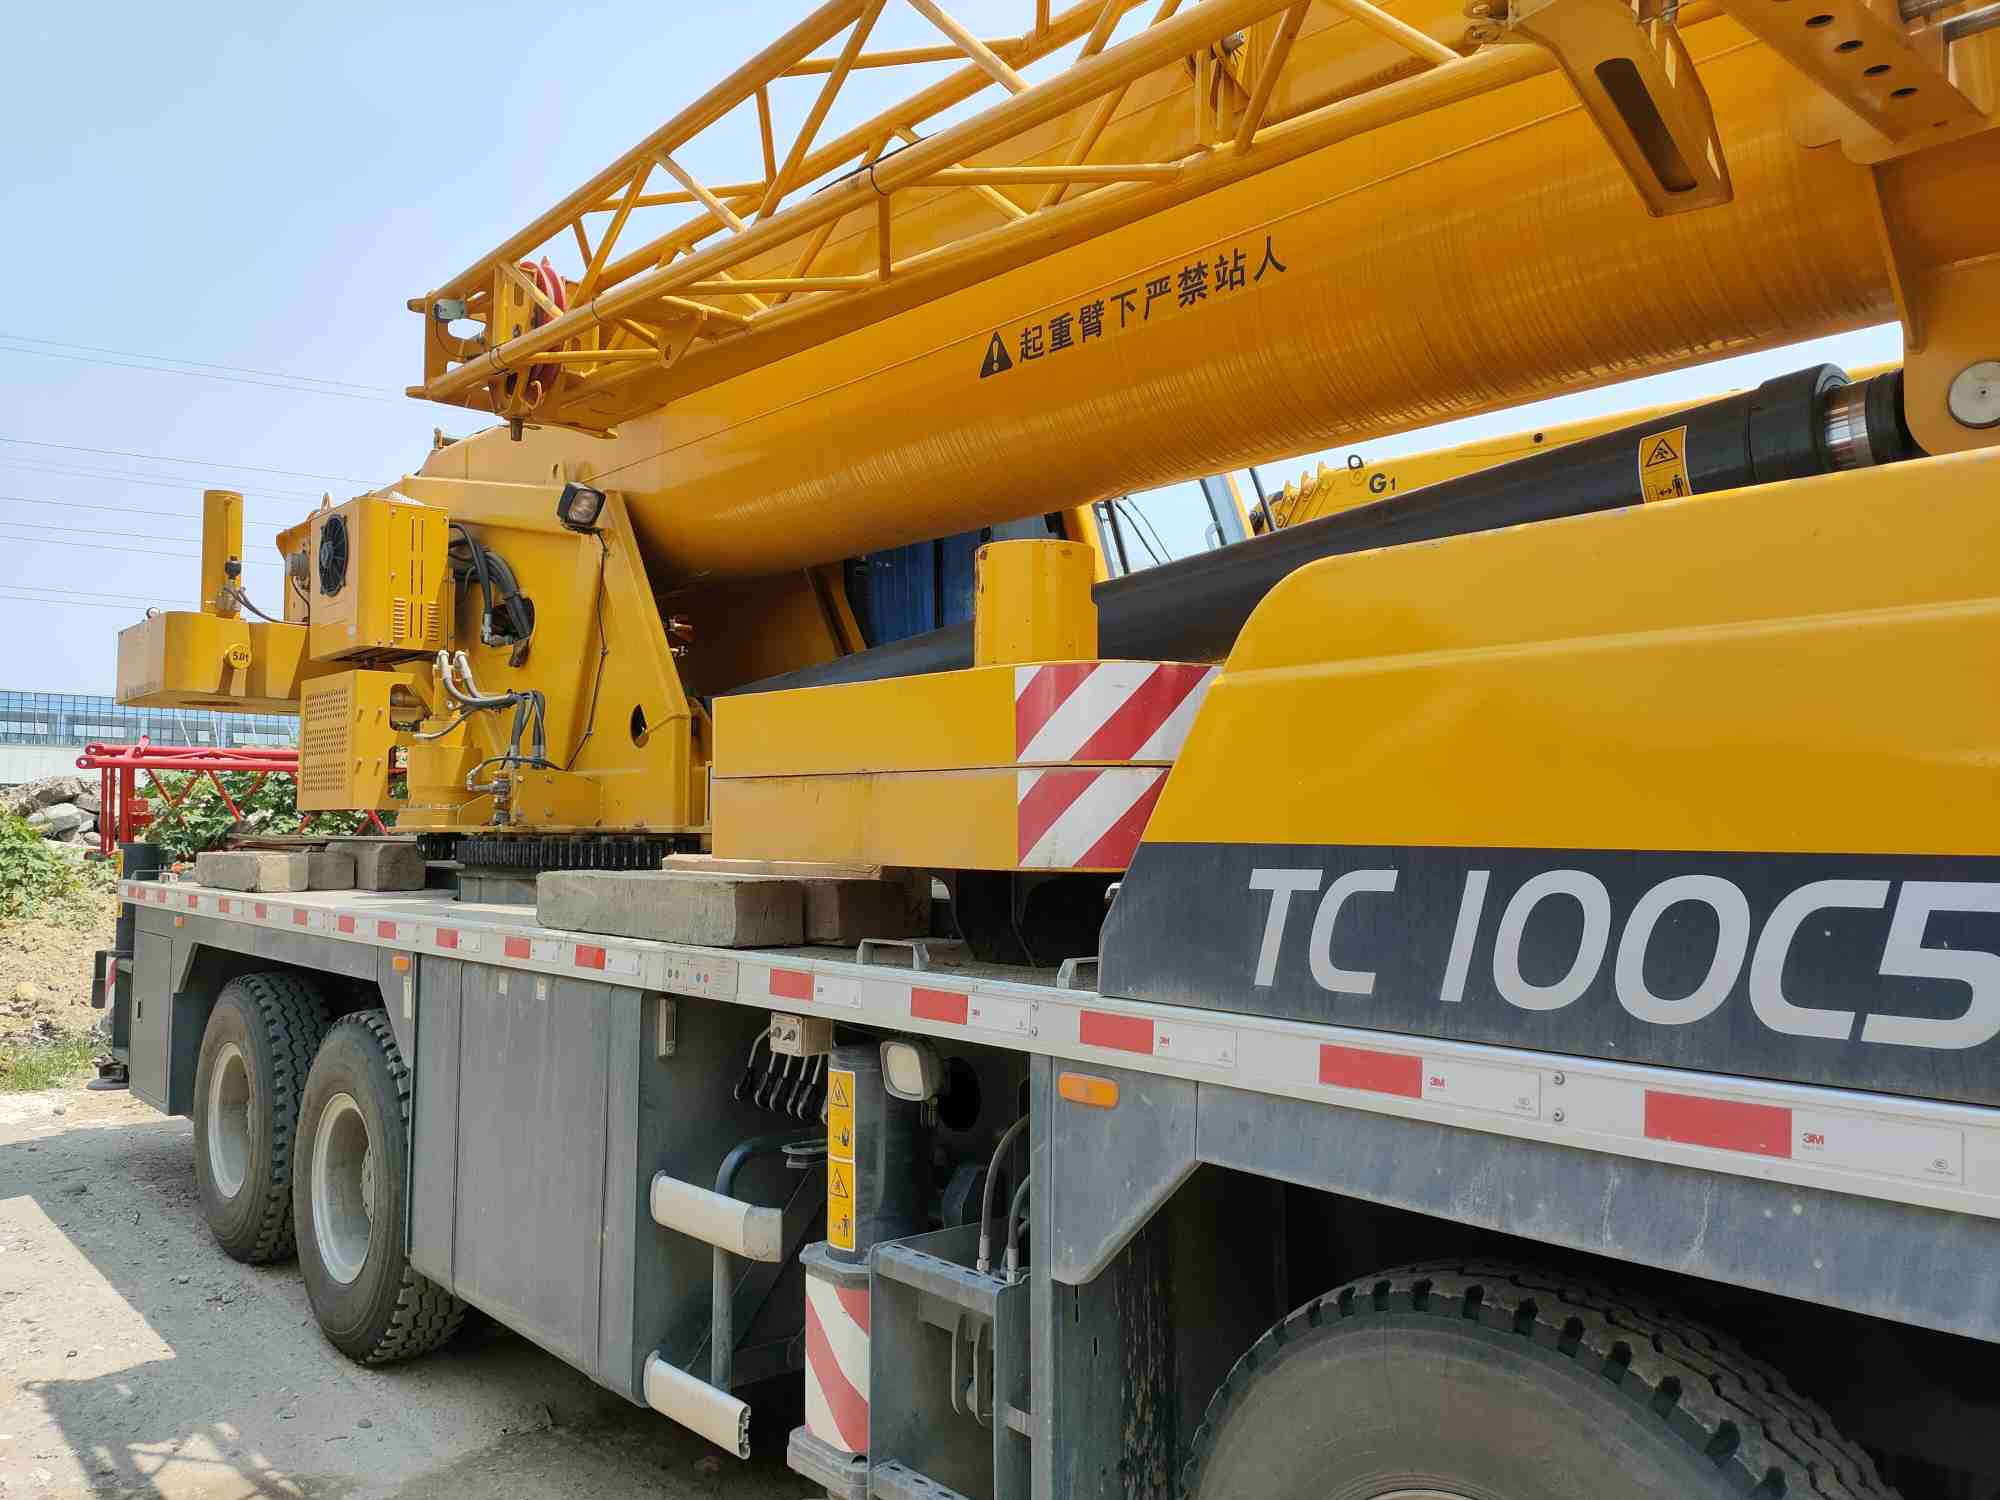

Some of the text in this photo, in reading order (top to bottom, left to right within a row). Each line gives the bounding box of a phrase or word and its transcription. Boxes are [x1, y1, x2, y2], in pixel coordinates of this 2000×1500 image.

[1018, 235, 1287, 363] 起重臂下严禁站人
[1248, 868, 1999, 1050] TC 100C5
[1802, 1132, 1825, 1145] 3M
